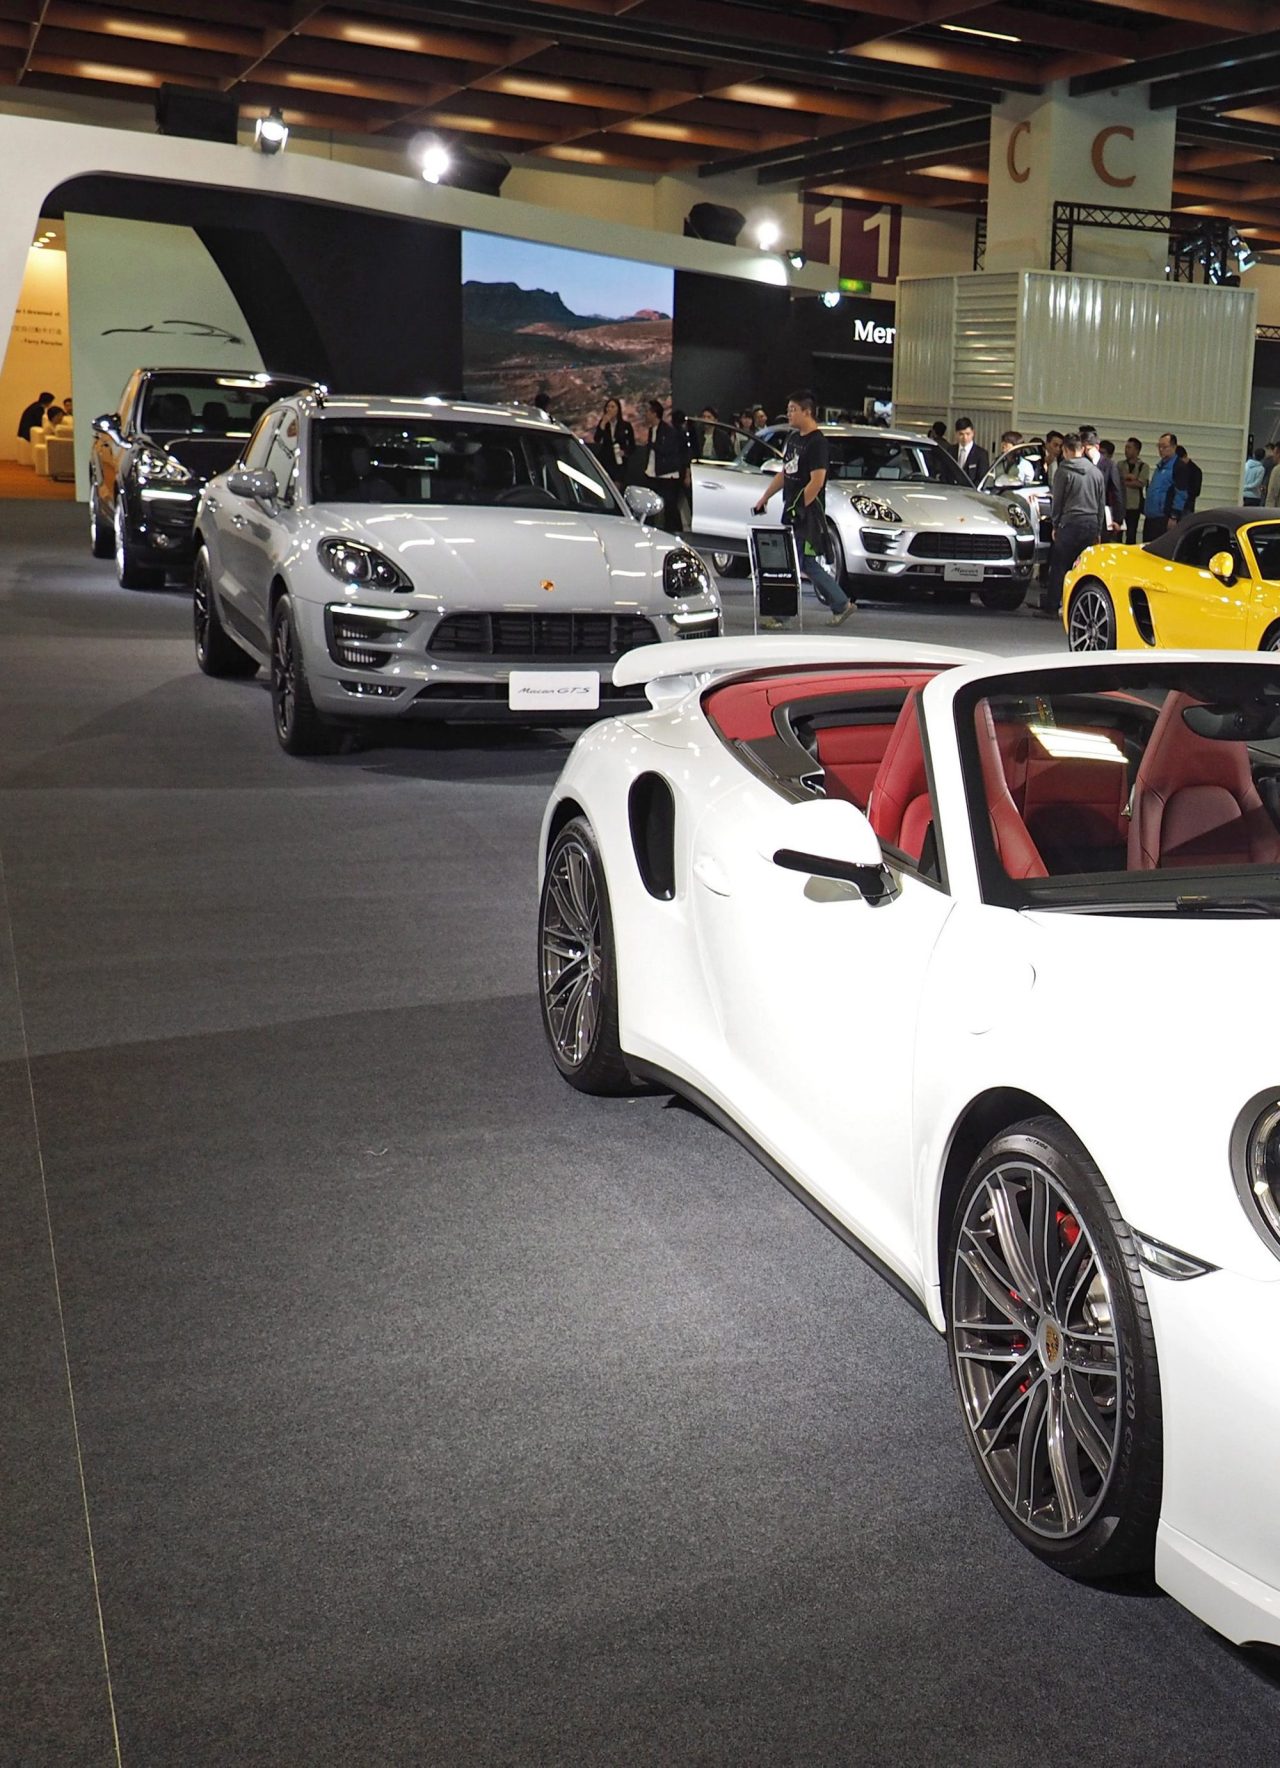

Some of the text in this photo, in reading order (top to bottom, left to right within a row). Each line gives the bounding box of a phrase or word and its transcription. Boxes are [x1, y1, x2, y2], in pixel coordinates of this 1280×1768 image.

[1007, 120, 1031, 183] C
[1091, 125, 1136, 188] C
[814, 198, 892, 278] 11
